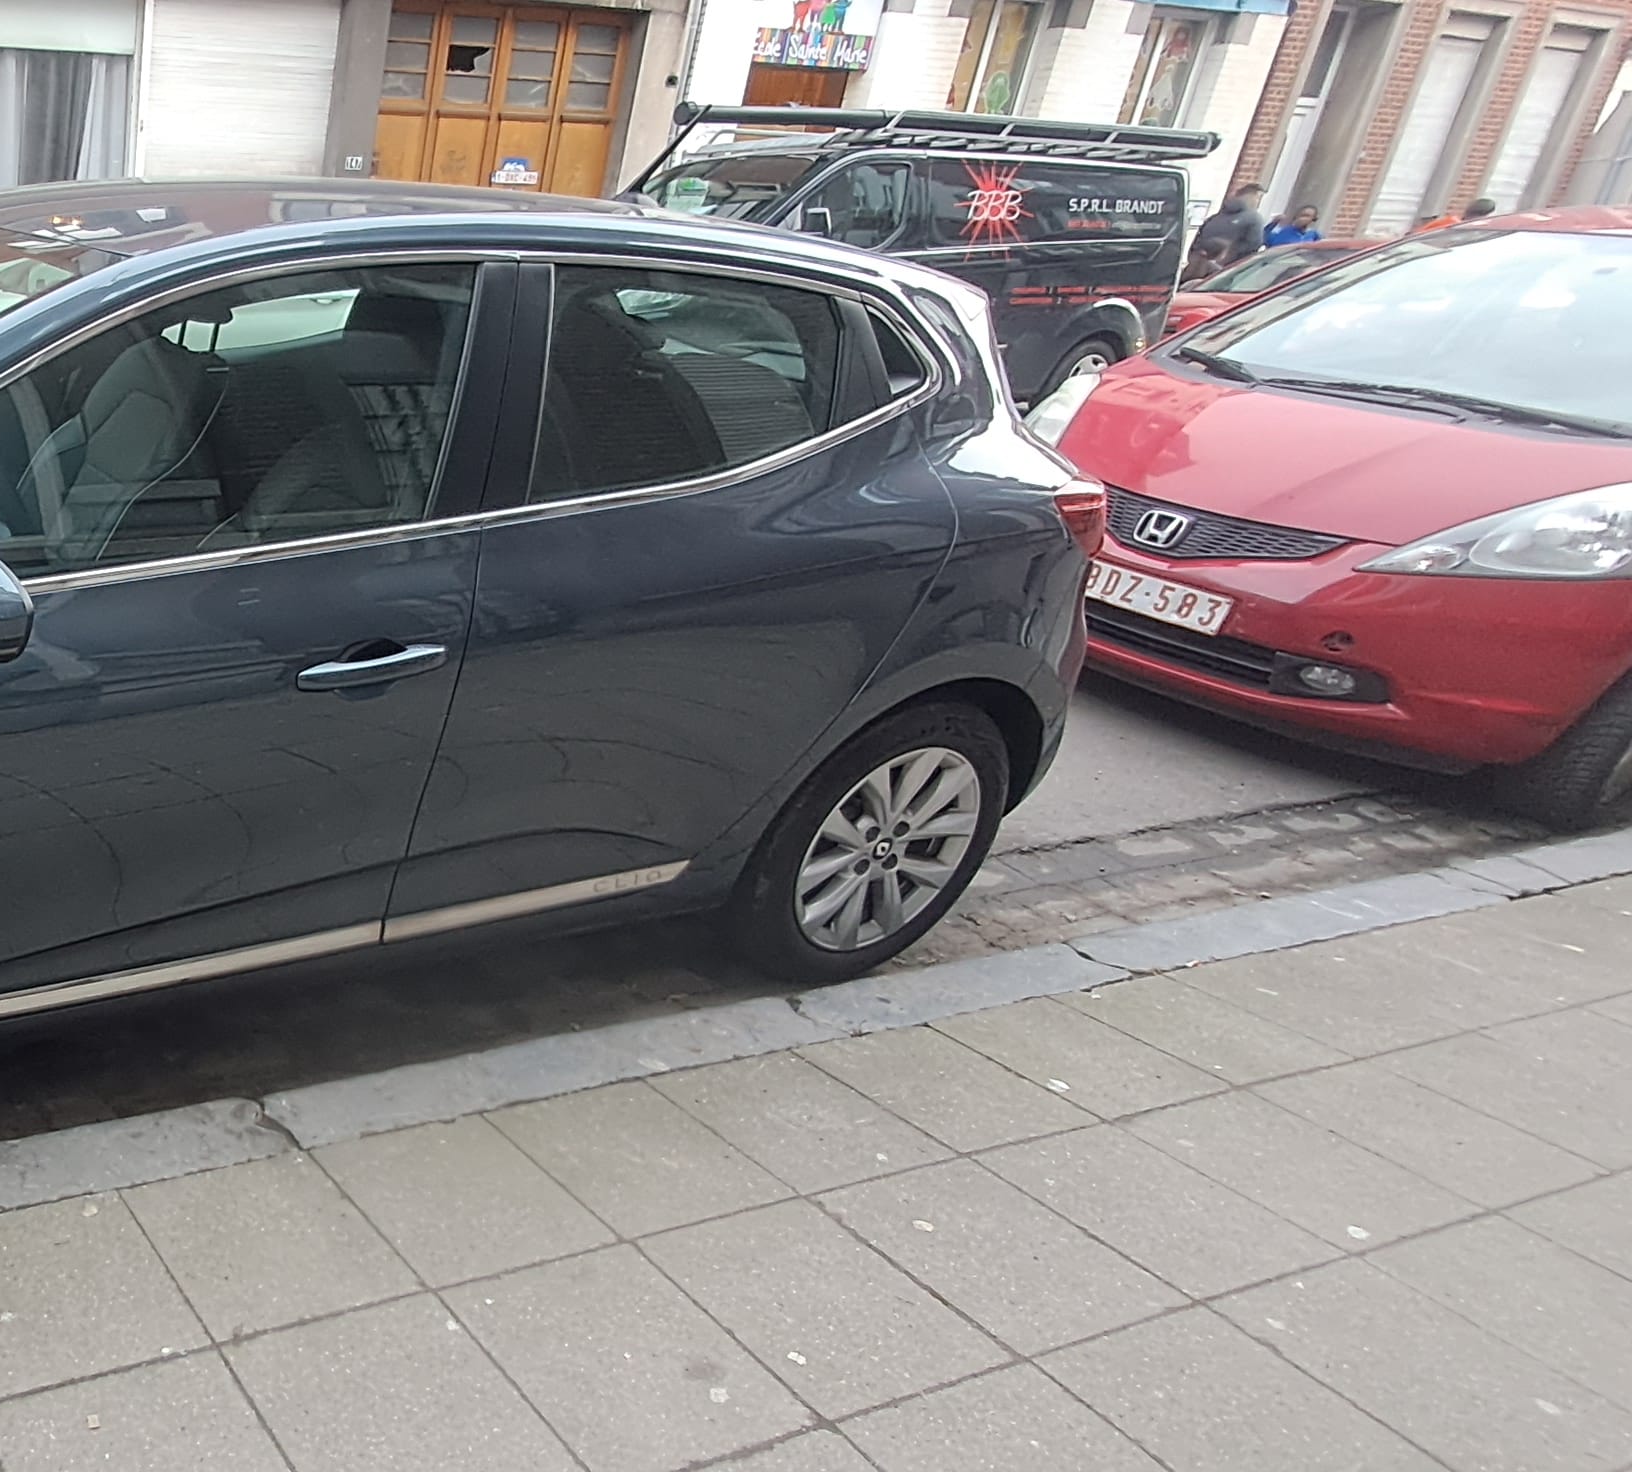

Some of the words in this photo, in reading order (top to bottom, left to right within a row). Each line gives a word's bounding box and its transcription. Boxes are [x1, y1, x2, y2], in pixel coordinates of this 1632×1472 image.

[789, 35, 828, 60] Sainte
[968, 190, 1022, 221] BBB
[1115, 199, 1166, 214] BRANDT
[593, 870, 662, 892] CLIO
